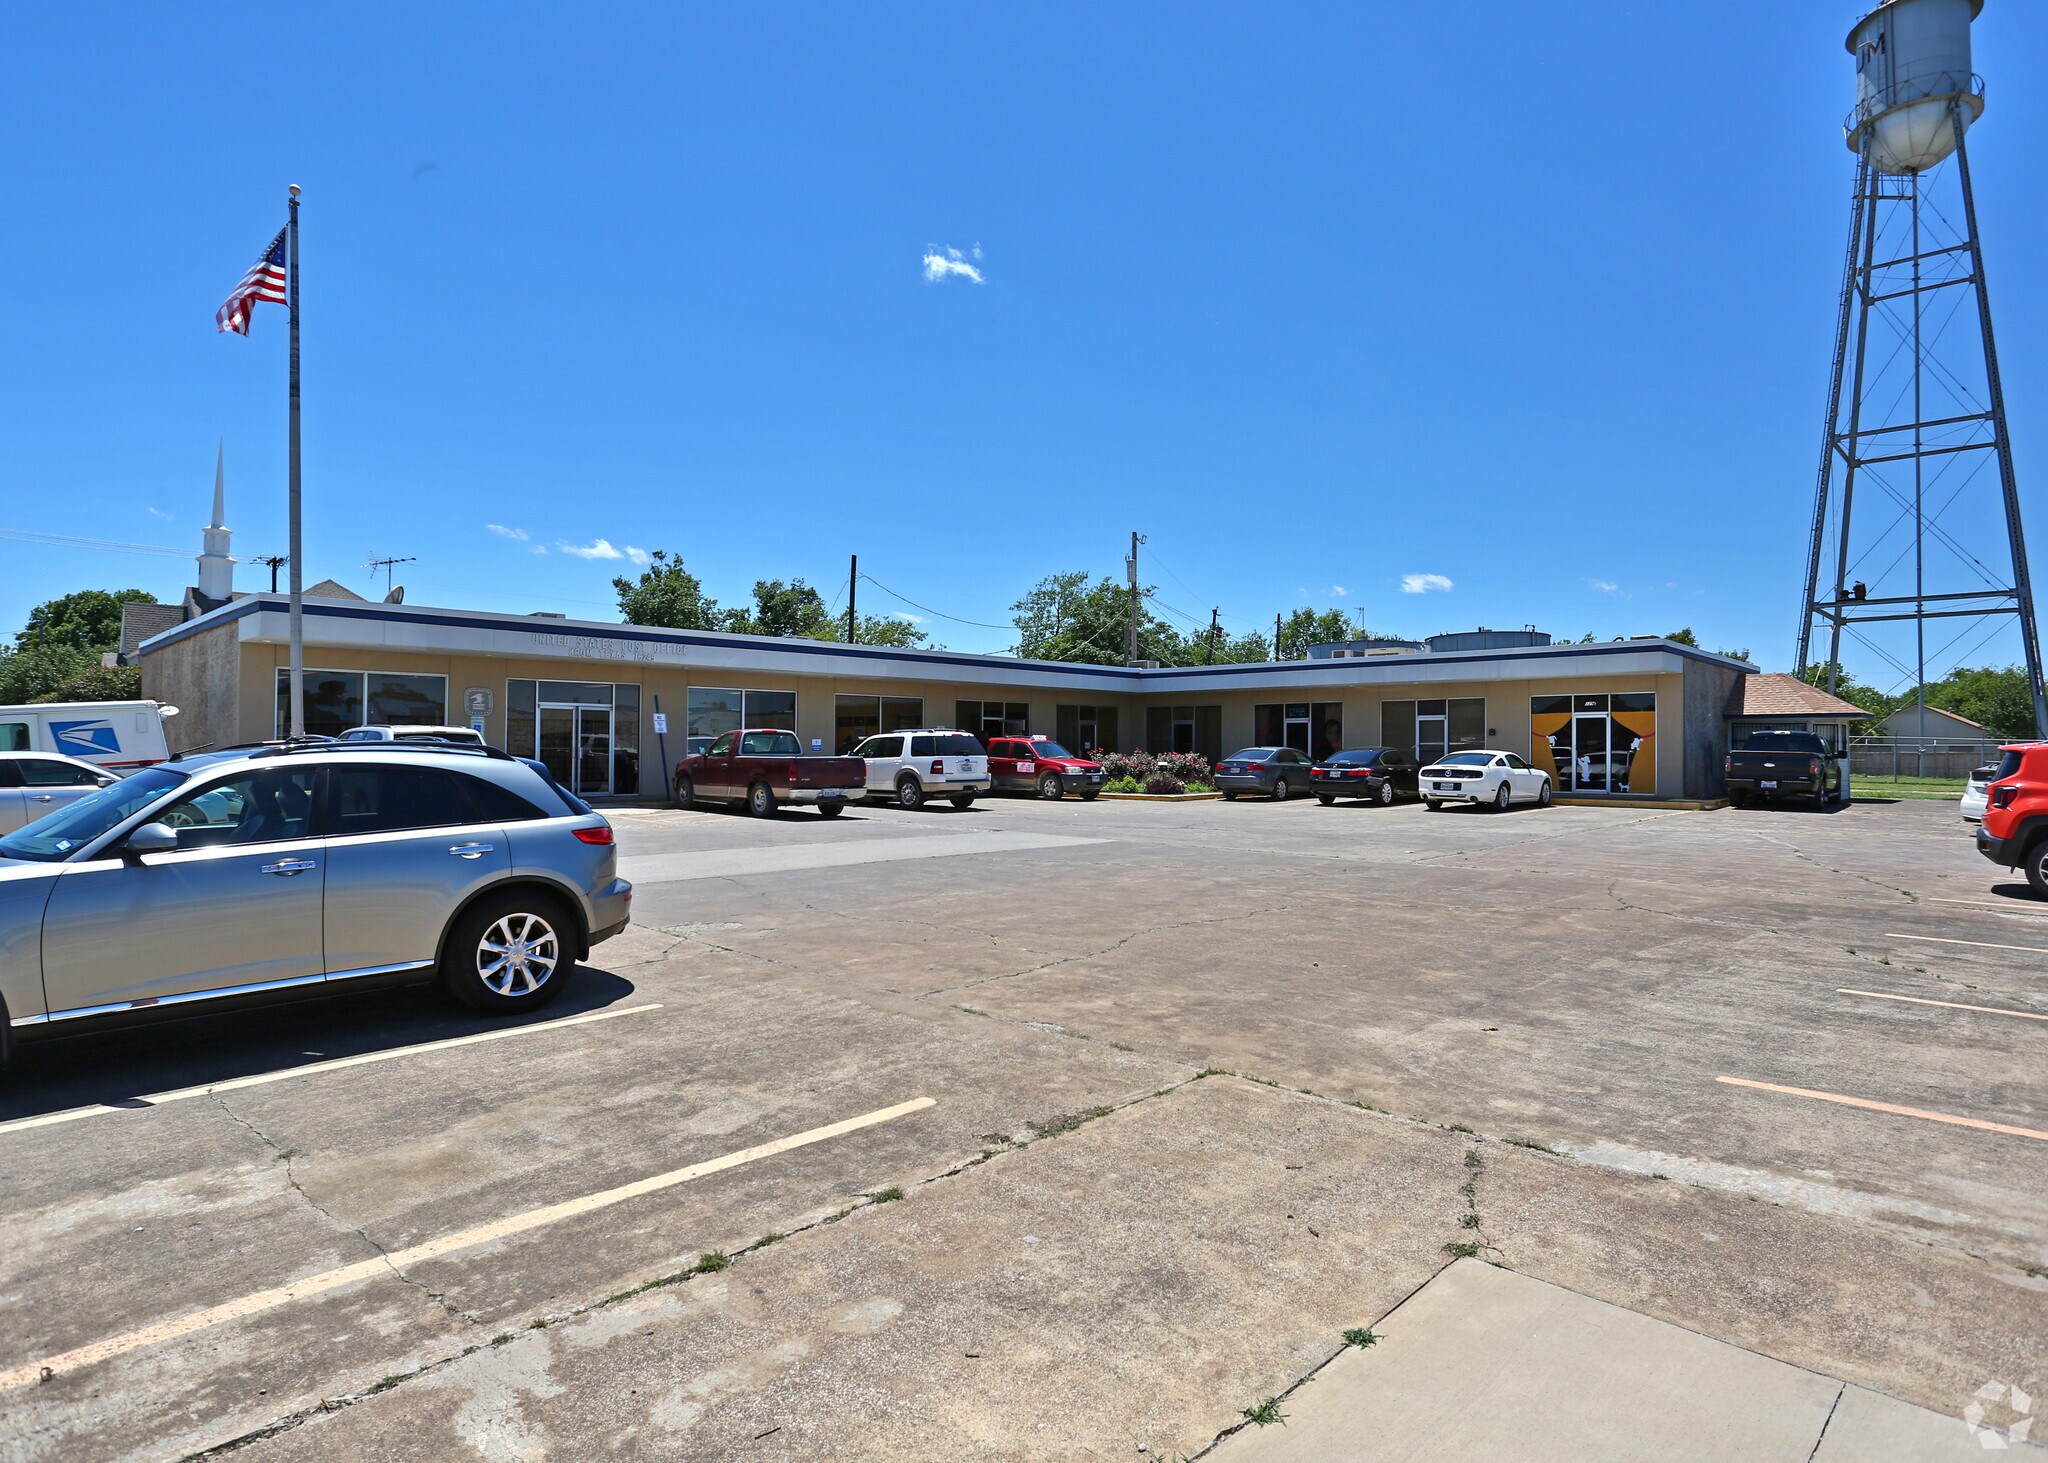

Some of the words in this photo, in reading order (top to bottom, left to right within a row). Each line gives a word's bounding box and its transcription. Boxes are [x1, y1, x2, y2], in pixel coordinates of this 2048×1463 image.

[531, 633, 569, 646] UNITED
[576, 636, 613, 650] STATES
[622, 640, 645, 652] POST
[653, 643, 688, 656] OFFICE
[568, 648, 592, 657] KRUM
[599, 650, 626, 660] TEXAS
